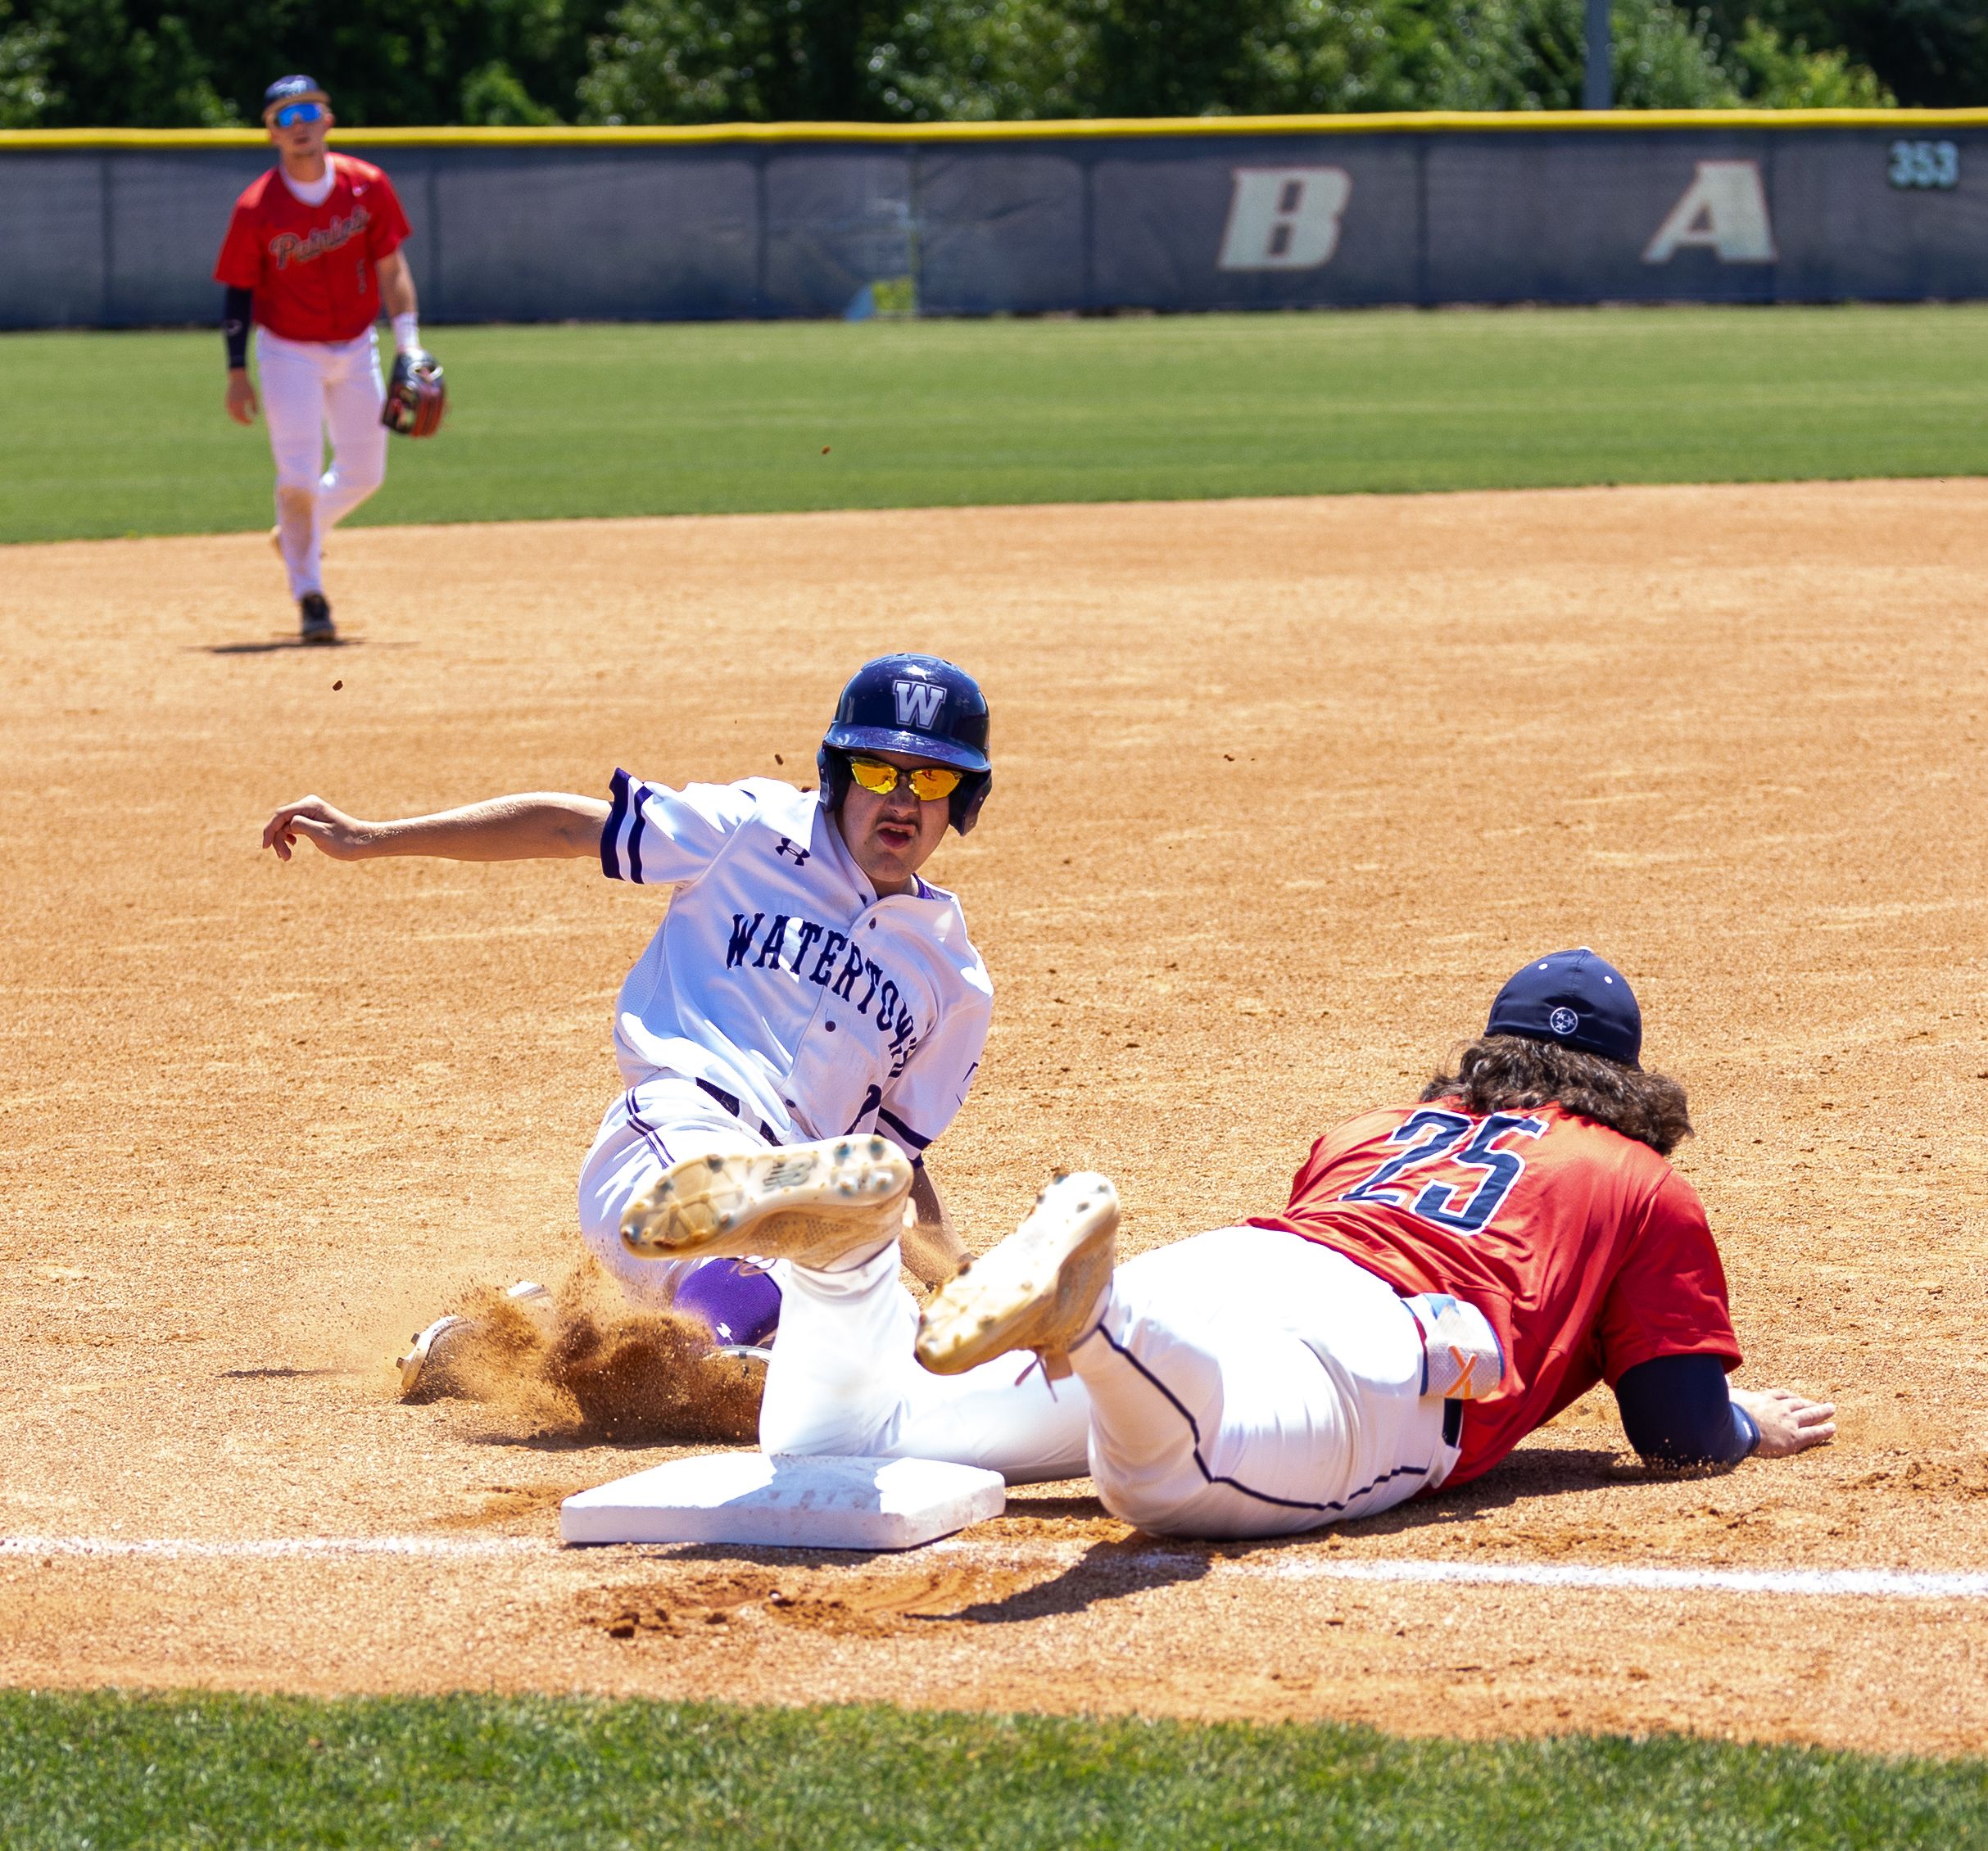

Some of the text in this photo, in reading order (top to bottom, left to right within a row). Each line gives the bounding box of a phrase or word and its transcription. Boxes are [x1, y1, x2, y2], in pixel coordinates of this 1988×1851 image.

[1888, 139, 1959, 186] 353
[1218, 161, 1777, 270] B A
[893, 679, 947, 731] W
[1338, 1108, 1550, 1236] 25
